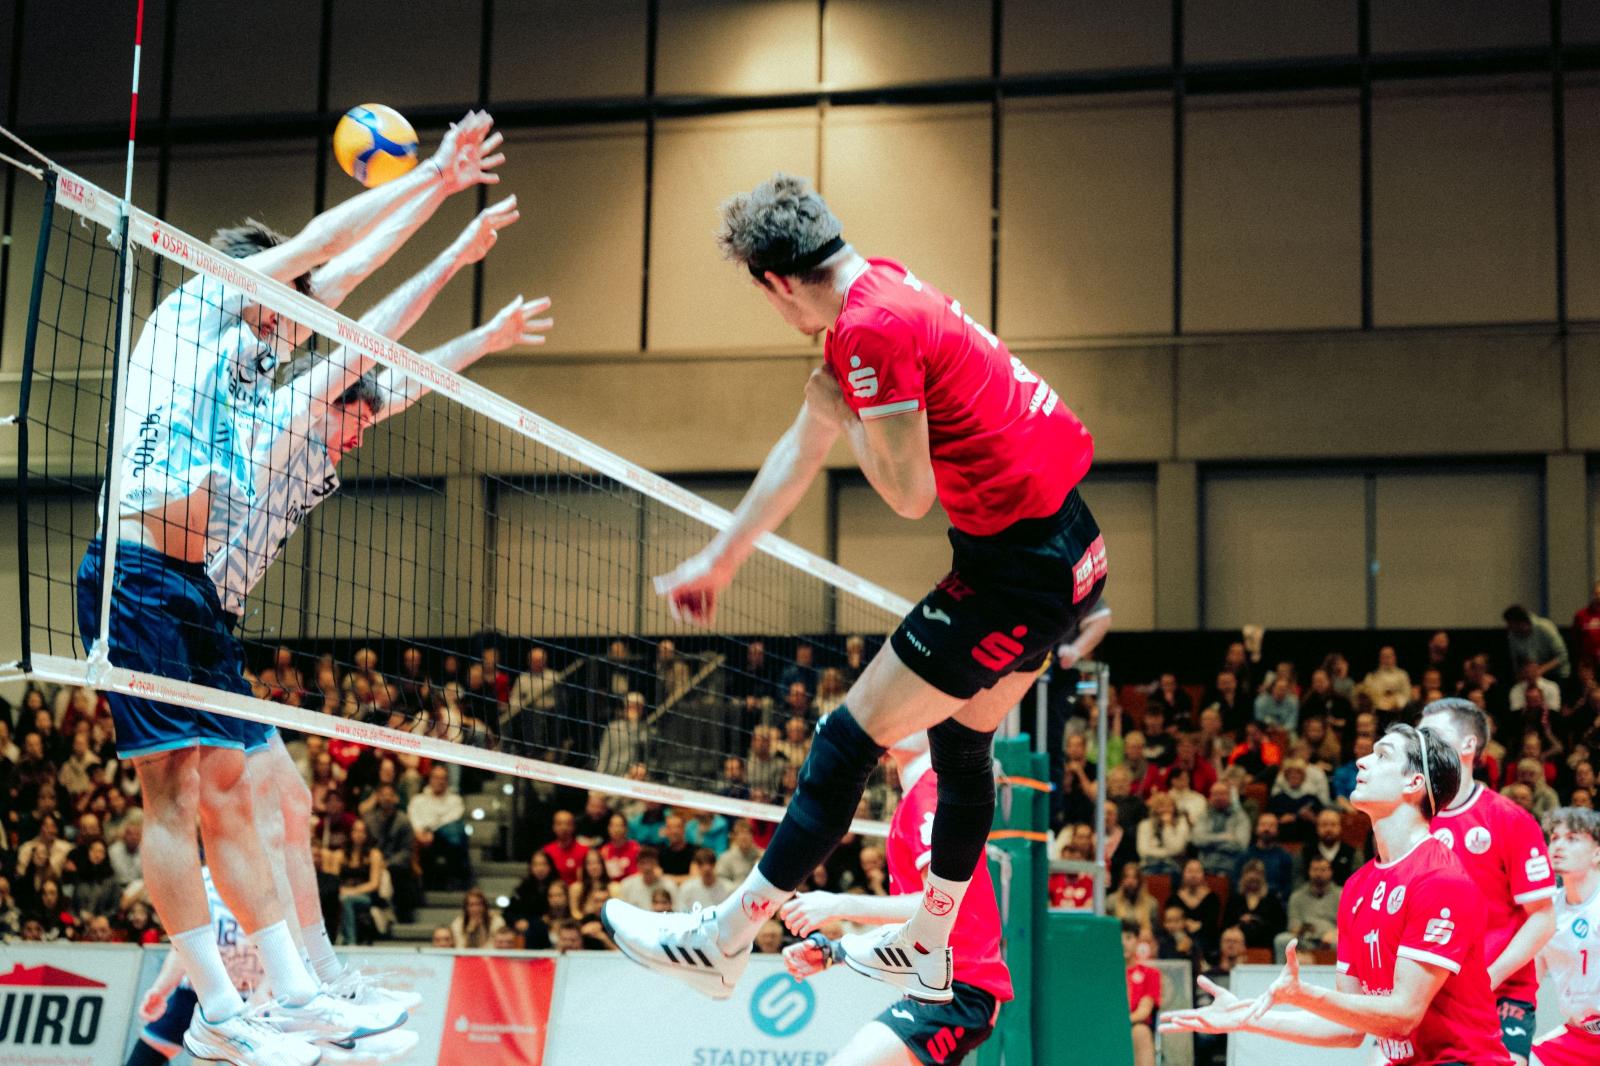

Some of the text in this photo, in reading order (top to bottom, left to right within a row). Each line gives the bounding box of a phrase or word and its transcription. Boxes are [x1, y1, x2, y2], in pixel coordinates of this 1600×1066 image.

[60, 176, 84, 197] NETZ
[163, 233, 188, 260] OSPA
[1579, 949, 1588, 976] 1
[694, 1048, 834, 1066] STADTWER
